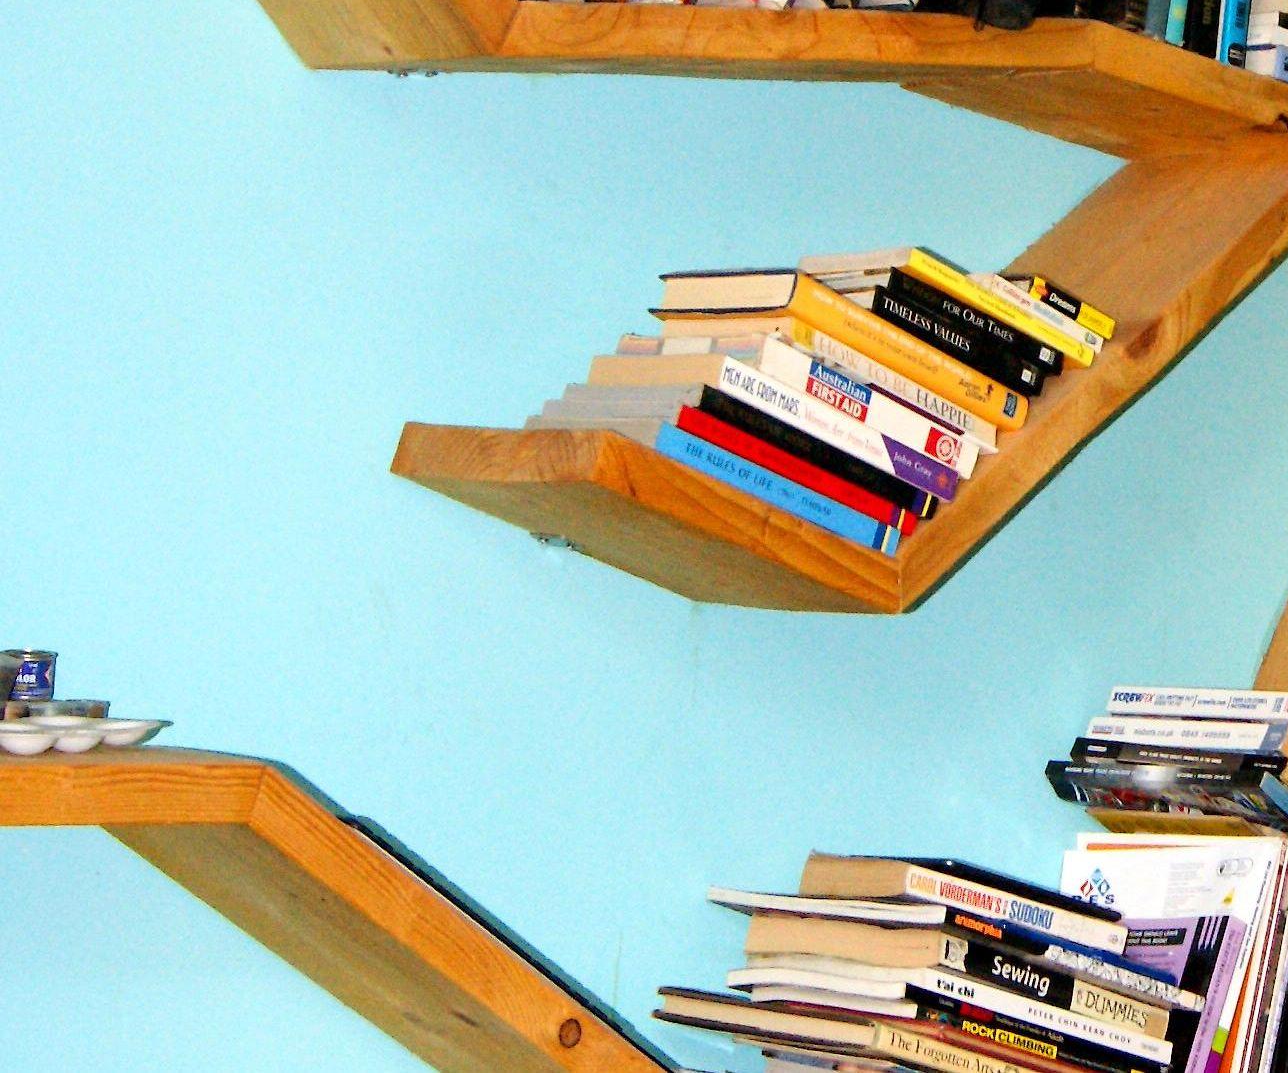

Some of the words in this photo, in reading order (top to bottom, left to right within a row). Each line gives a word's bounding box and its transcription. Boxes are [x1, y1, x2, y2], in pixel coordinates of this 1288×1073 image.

[879, 296, 934, 332] TIMELESS
[930, 322, 973, 351] VALUES
[940, 297, 963, 317] FOR
[813, 334, 858, 367] HOW
[863, 361, 888, 384] TO
[718, 360, 746, 389] MEN
[737, 370, 761, 395] ARE
[752, 376, 783, 407] FROM
[774, 388, 805, 417] MARS
[808, 379, 843, 408] FIRST
[836, 394, 865, 419] AID
[811, 364, 871, 404] Australian
[703, 450, 738, 475] RULES
[735, 465, 752, 481] OF
[751, 472, 774, 491] LIFE
[891, 451, 913, 468] John
[1112, 692, 1154, 704] SCREWFIX
[910, 873, 937, 895] CAROL
[939, 880, 1002, 914] VORDERMAN'S
[1008, 900, 1055, 930] SUDOKU
[936, 978, 955, 994] t'ai
[957, 985, 976, 999] chi
[991, 955, 1051, 998] Sewing
[1028, 1007, 1054, 1022] PETER
[1058, 1015, 1079, 1029] CHIN
[1085, 990, 1150, 1030] DUMMIES
[889, 1032, 913, 1051] The
[915, 1039, 968, 1069] Forgotten
[961, 1020, 995, 1041] ROCK
[996, 1028, 1056, 1059] CLIMBING
